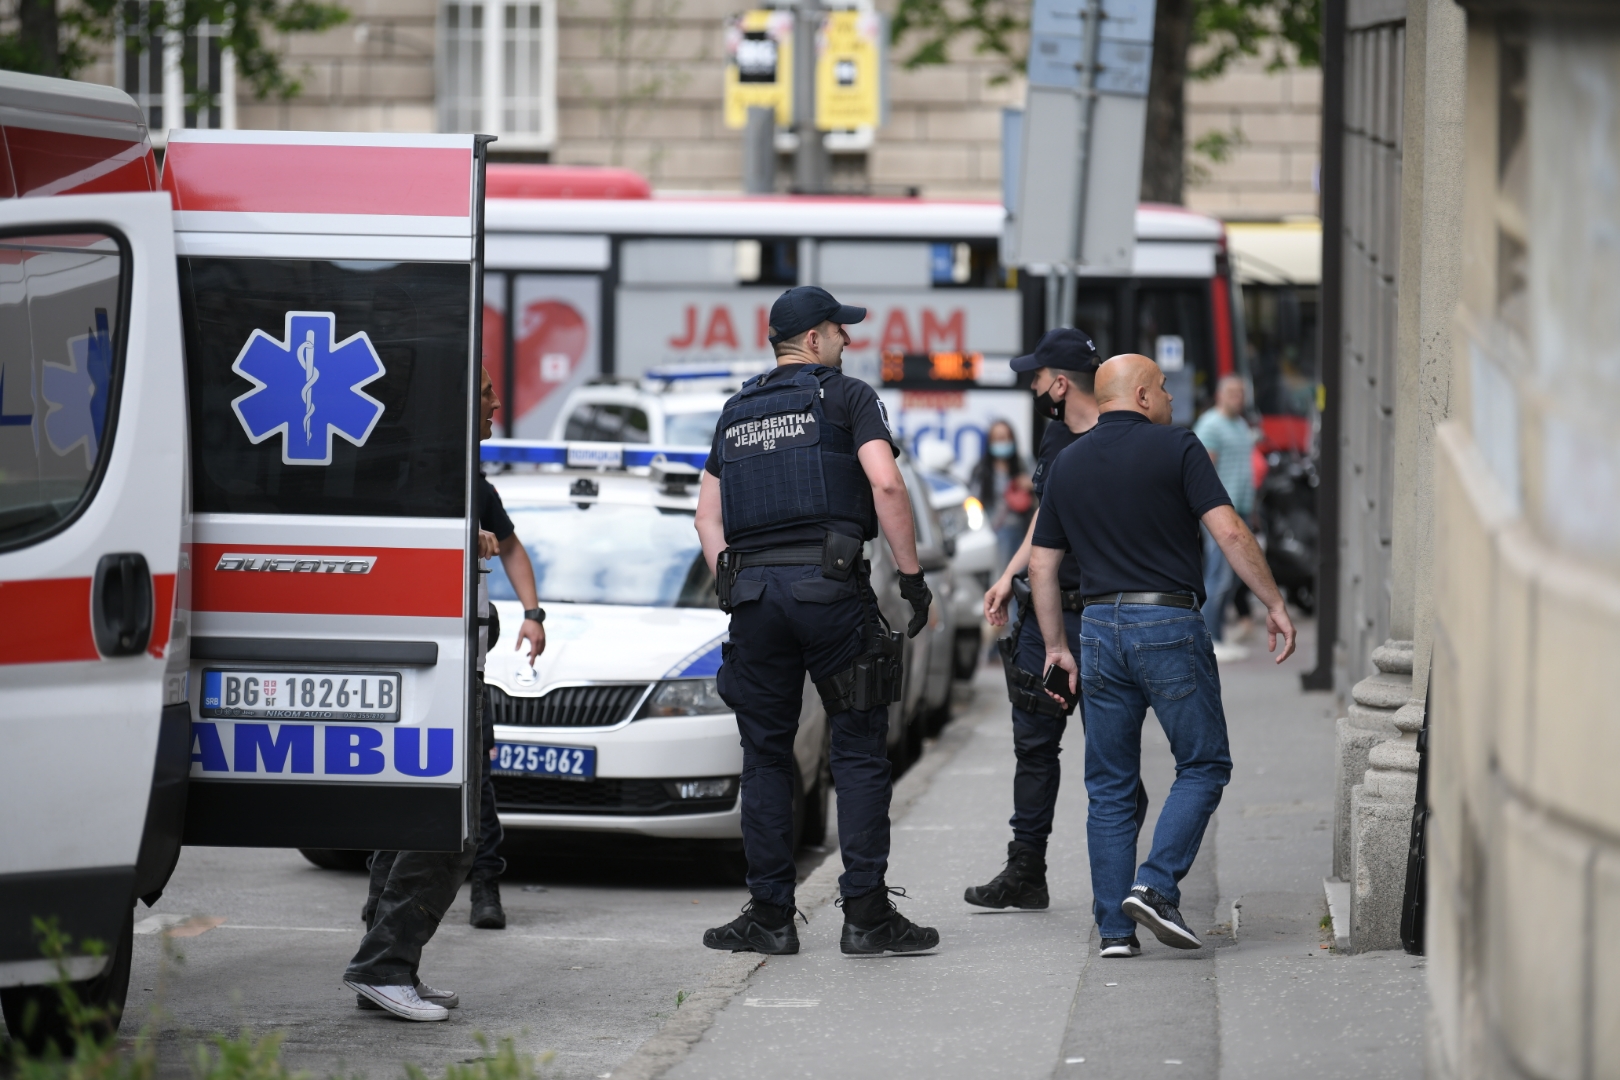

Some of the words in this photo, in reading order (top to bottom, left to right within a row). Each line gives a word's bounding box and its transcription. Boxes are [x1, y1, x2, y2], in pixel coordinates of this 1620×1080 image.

[725, 412, 815, 440] ИНТЕРВЕНТНА
[734, 424, 805, 448] ЈЕДИНИЦА
[763, 439, 776, 451] 92
[216, 557, 370, 574] DUCATO
[225, 676, 260, 706] BG
[205, 697, 219, 706] SRB
[265, 710, 301, 718] NIKOM
[303, 711, 332, 719] AUTO
[189, 722, 454, 778] AMBU
